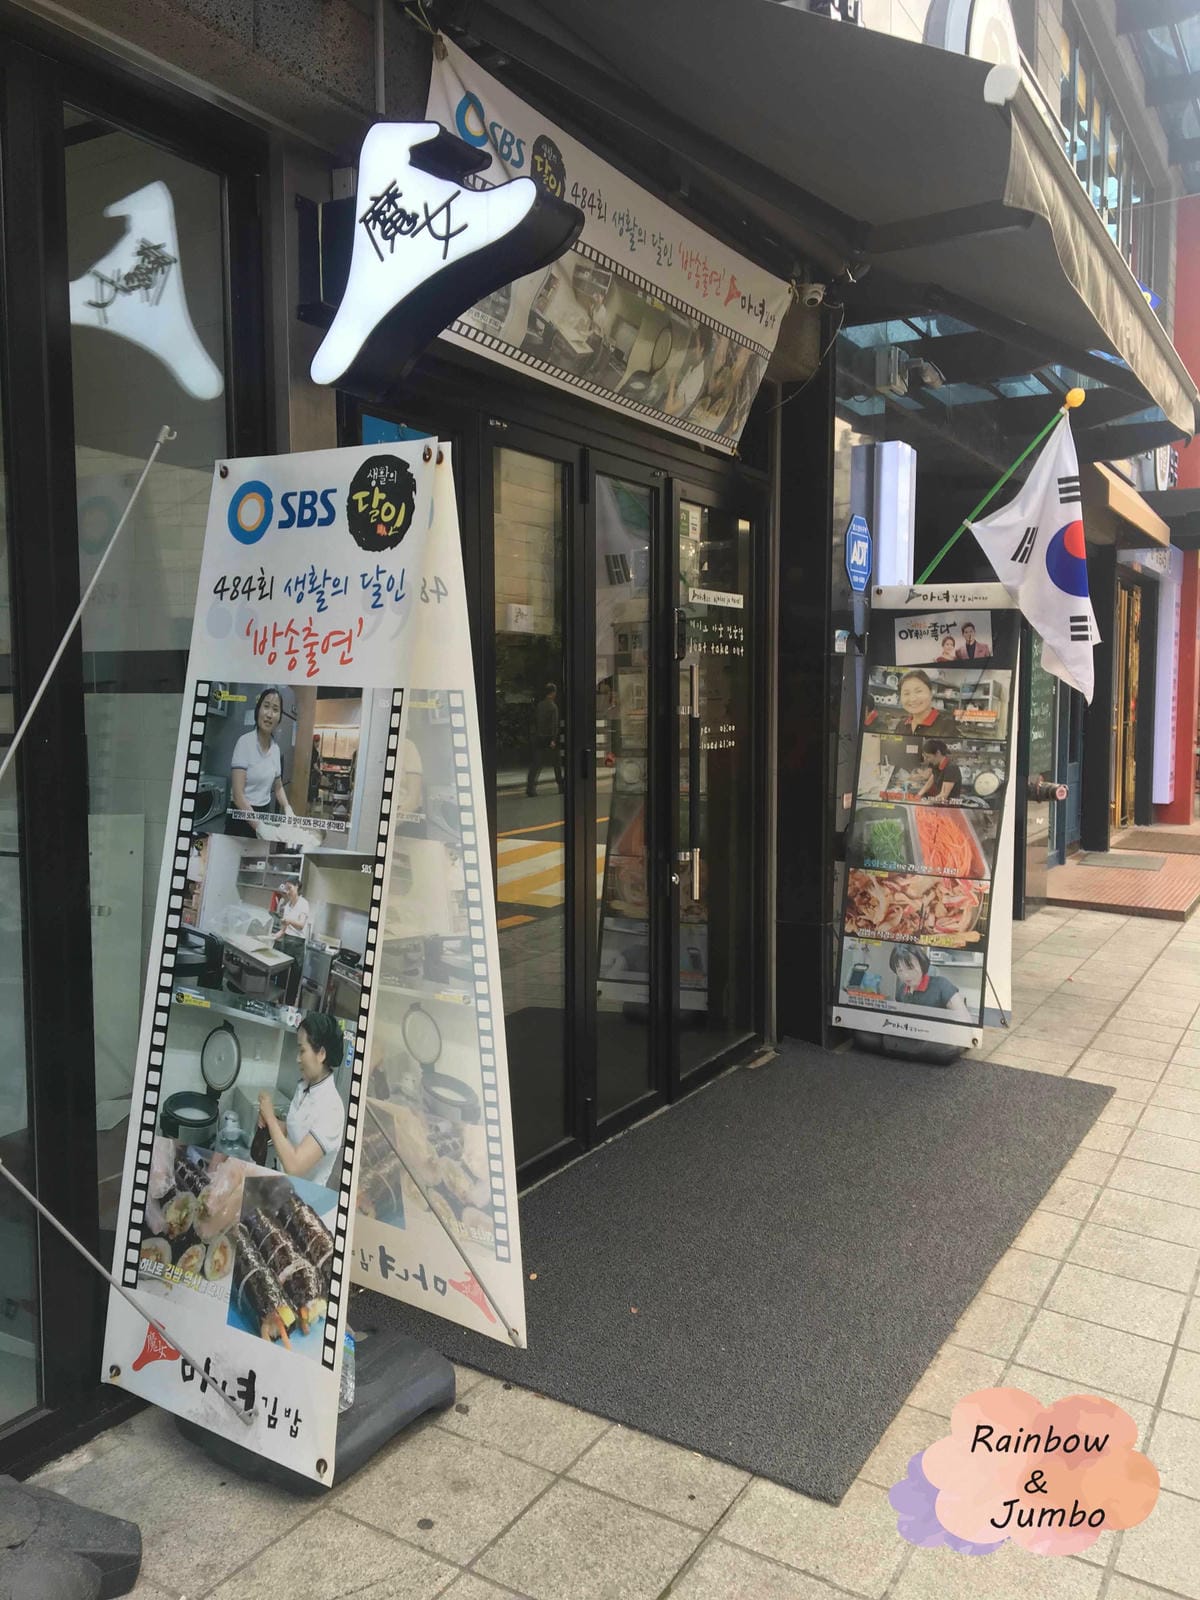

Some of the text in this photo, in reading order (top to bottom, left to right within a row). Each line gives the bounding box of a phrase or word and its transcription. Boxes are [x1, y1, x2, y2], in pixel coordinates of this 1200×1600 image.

[489, 121, 526, 169] SBS
[571, 182, 608, 222] 484회
[612, 208, 646, 251] 생활의
[651, 232, 673, 266] 달인
[367, 465, 398, 487] 생활의
[277, 487, 338, 530] SBS
[352, 486, 406, 537] 달인
[850, 540, 868, 567] ADT
[213, 565, 406, 613] 484회 생활의 달인
[711, 642, 729, 655] take
[732, 645, 744, 657] out
[361, 863, 373, 874] SBS
[164, 1263, 184, 1283] 김밥
